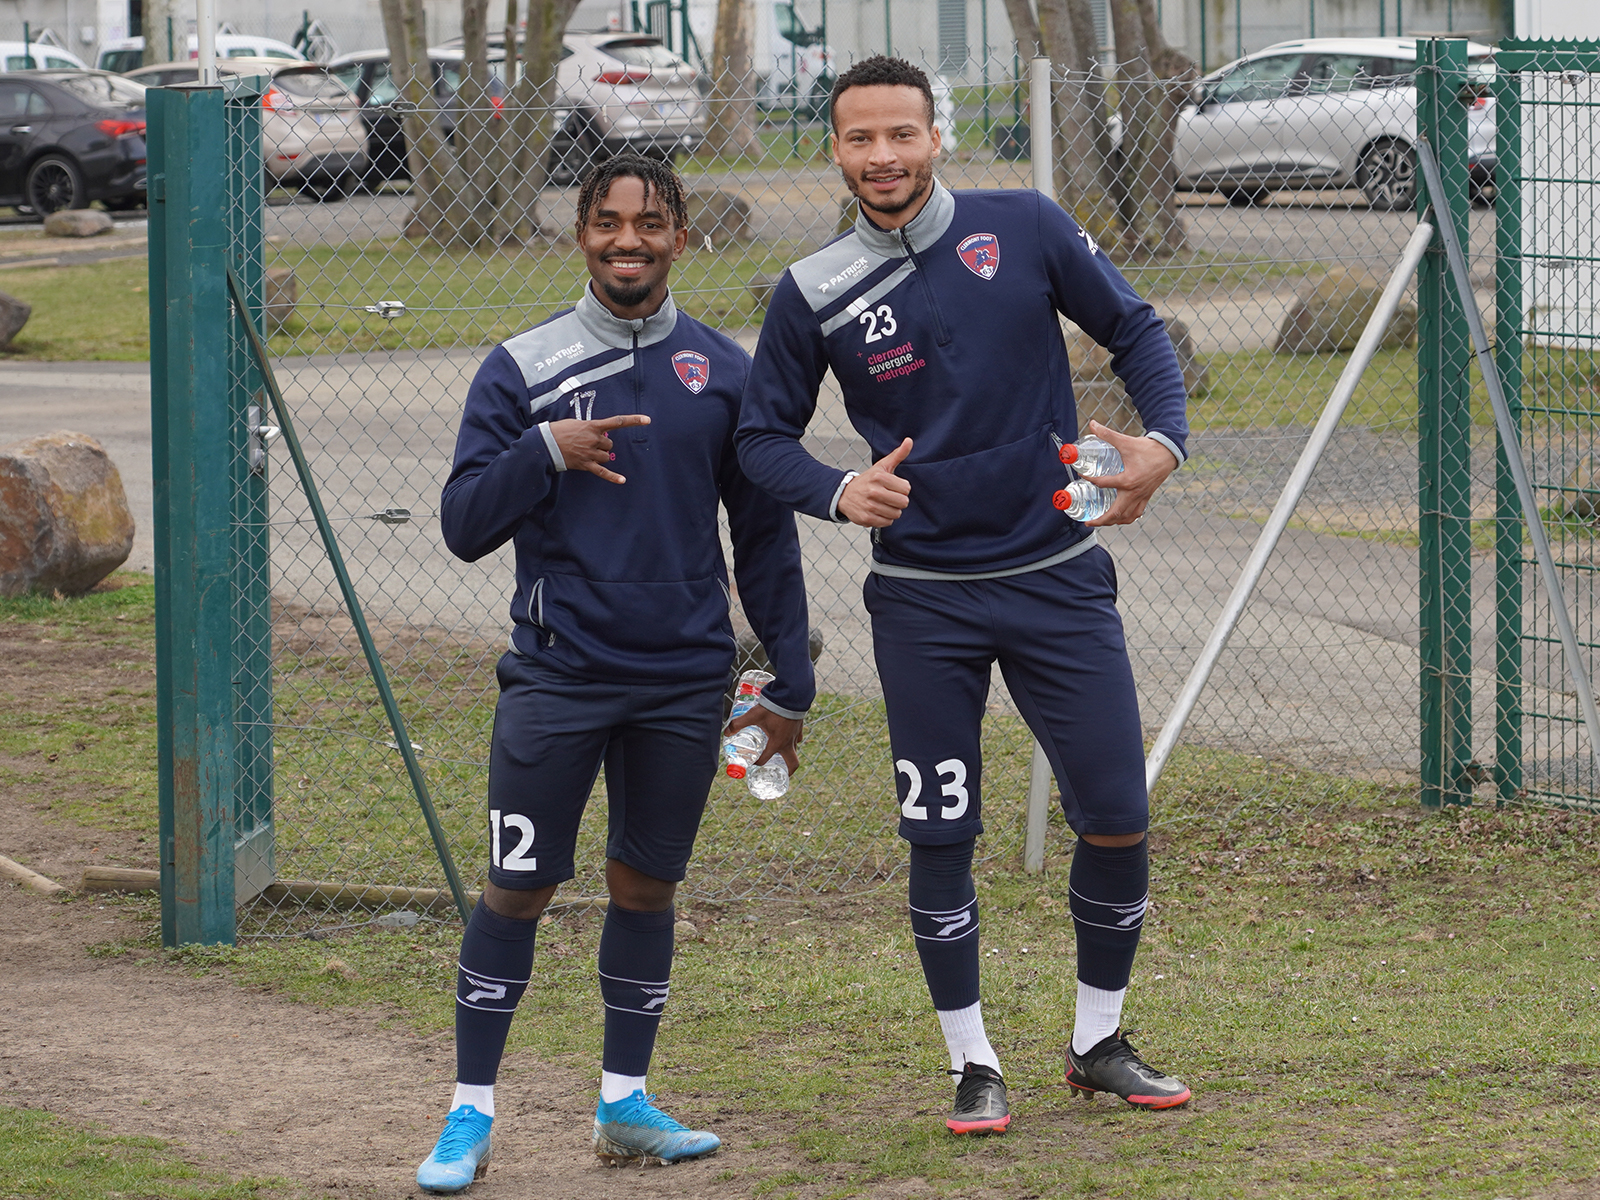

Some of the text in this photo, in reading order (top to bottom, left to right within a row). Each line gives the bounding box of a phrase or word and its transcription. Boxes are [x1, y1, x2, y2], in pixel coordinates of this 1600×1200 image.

[960, 236, 979, 251] CLERMONT
[829, 256, 868, 286] PATRICK
[860, 304, 897, 344] 23
[544, 341, 584, 367] PATRICK
[867, 341, 914, 365] clermont
[868, 353, 913, 375] auvergne
[876, 358, 926, 383] métropole
[569, 390, 596, 421] 17
[897, 758, 969, 821] 23
[489, 809, 537, 872] 12
